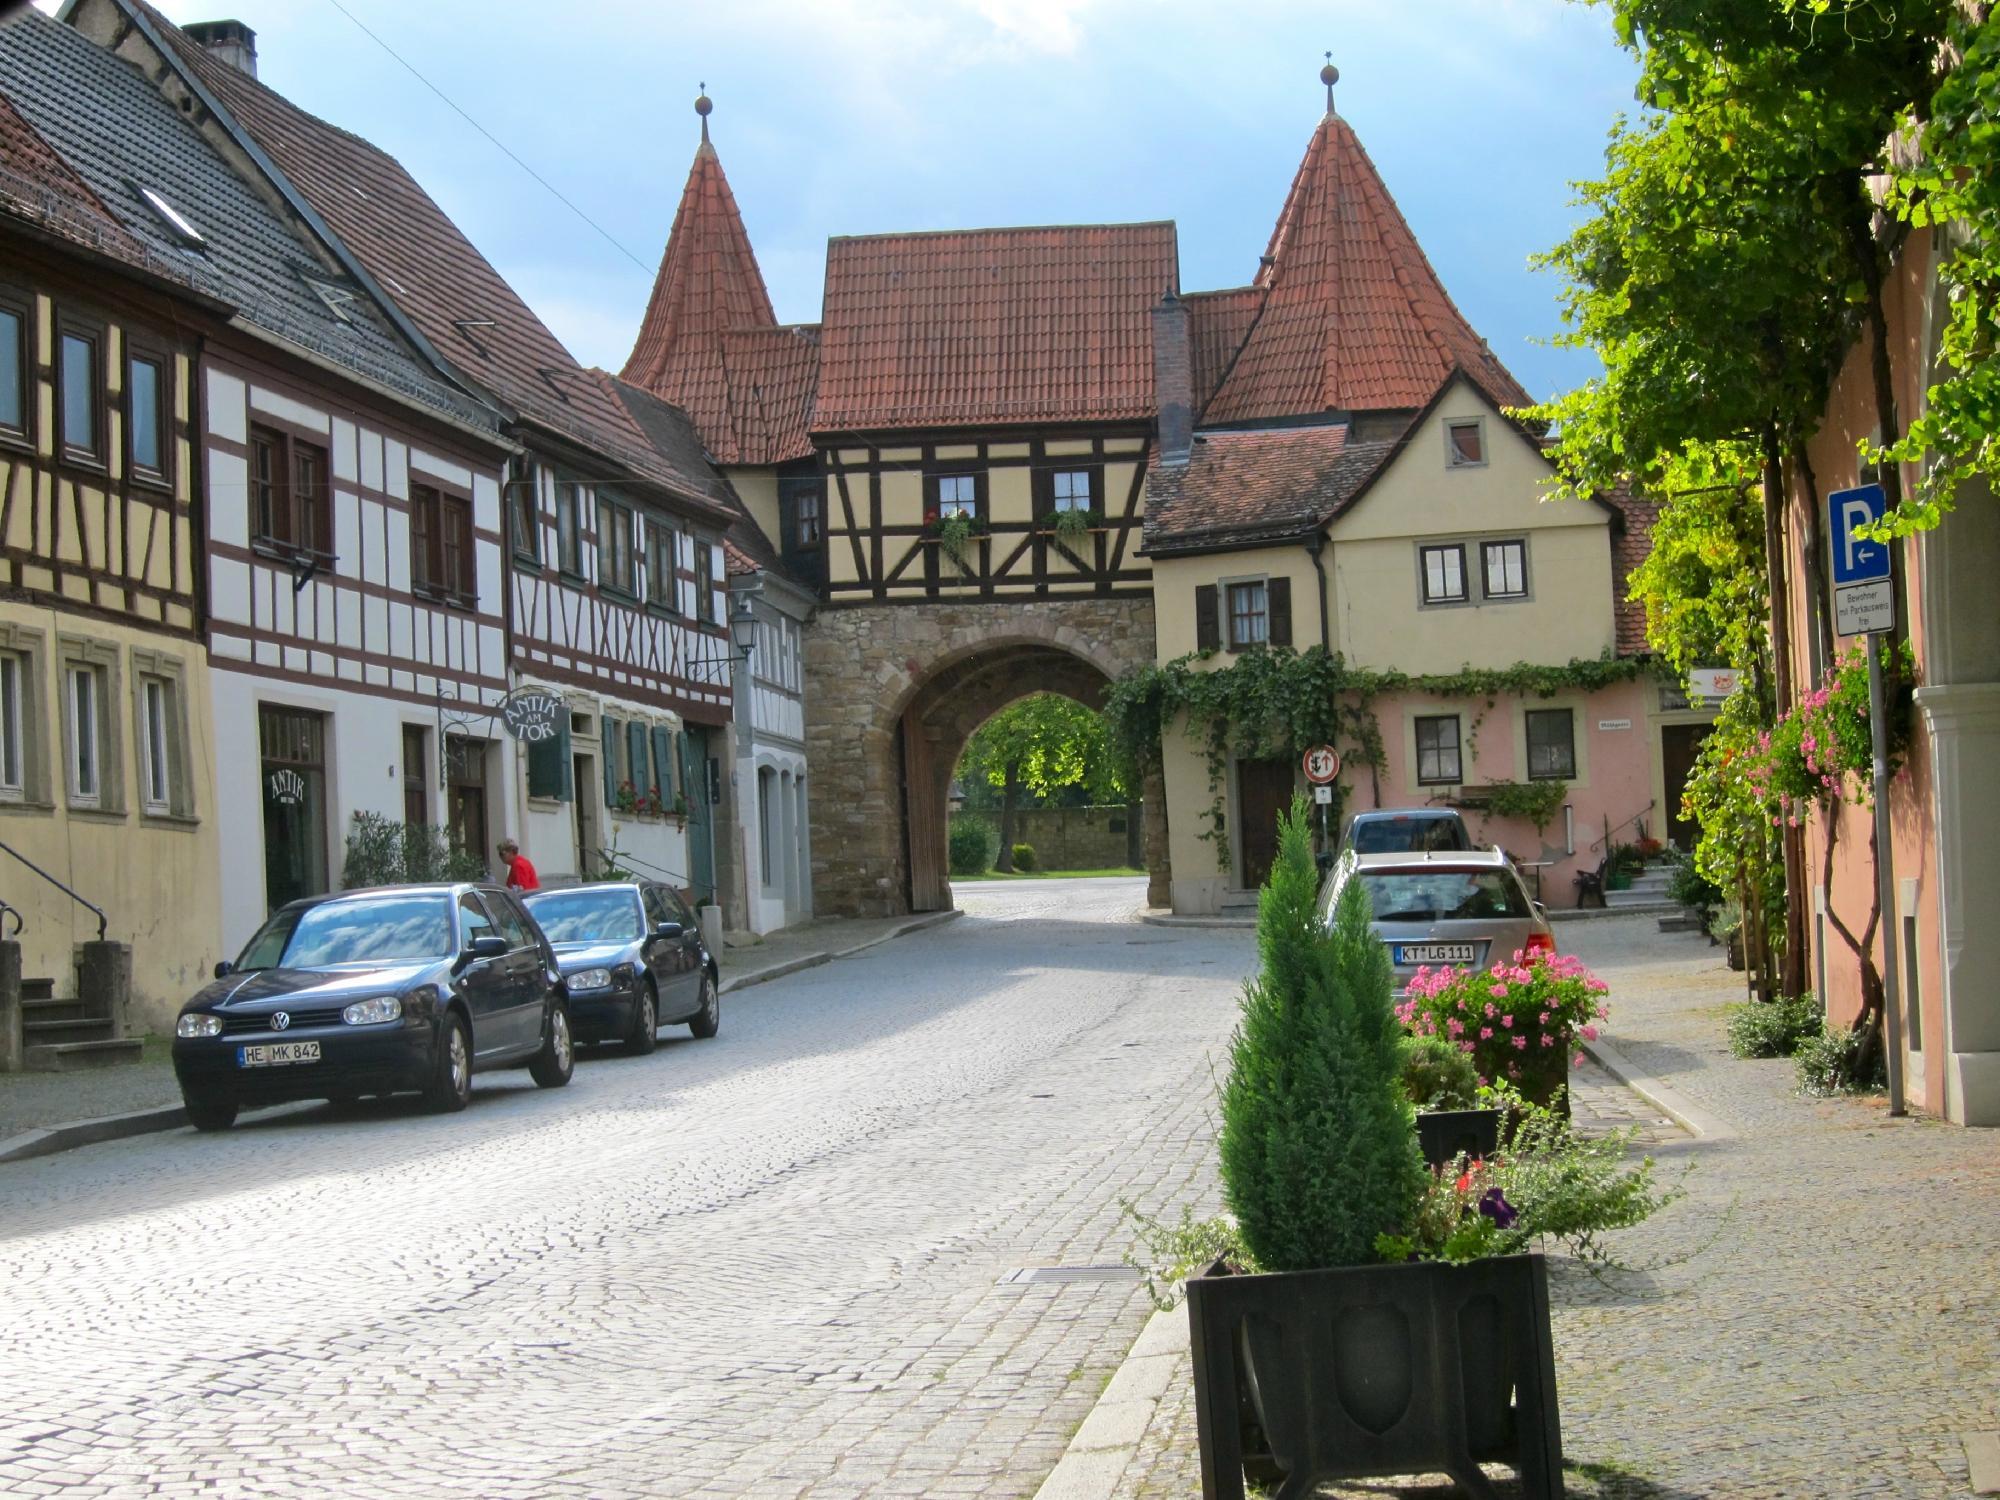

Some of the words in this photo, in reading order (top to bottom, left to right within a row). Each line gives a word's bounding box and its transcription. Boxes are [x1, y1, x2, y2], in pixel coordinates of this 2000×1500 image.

[1842, 500, 1873, 570] P
[1847, 591, 1878, 603] Bewohner
[1850, 602, 1889, 615] Parkausweis
[505, 696, 558, 725] ANTIK
[526, 713, 541, 723] AM
[516, 722, 555, 741] TOR
[271, 768, 304, 802] ANTIK
[1402, 947, 1419, 960] KT
[245, 1047, 264, 1062] HE
[272, 1045, 290, 1060] MK
[293, 1043, 319, 1059] 842
